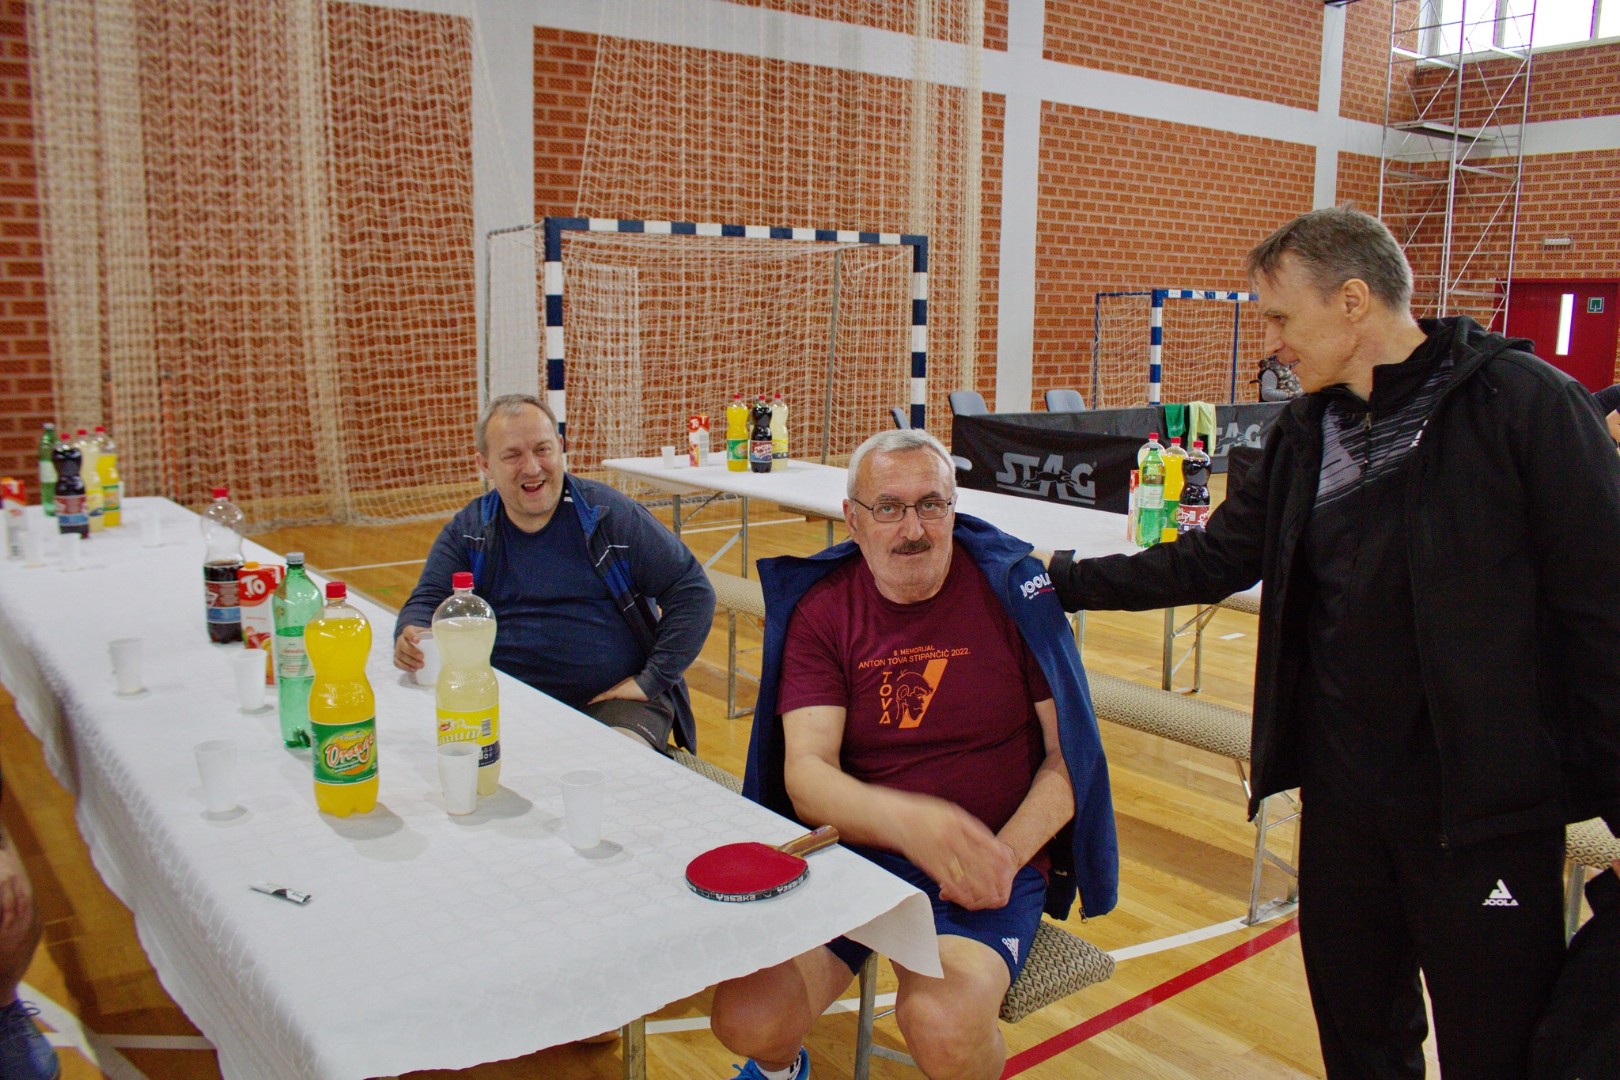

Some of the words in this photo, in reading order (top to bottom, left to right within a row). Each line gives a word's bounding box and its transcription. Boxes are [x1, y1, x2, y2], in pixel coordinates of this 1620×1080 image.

[995, 452, 1096, 504] STAG
[858, 659, 885, 668] ANTON
[888, 656, 908, 665] TOVA
[909, 650, 949, 661] STIPANČIĆ
[901, 645, 934, 655] MEMORIJAL
[879, 672, 892, 723] TOVA
[1482, 898, 1519, 906] JOOLA
